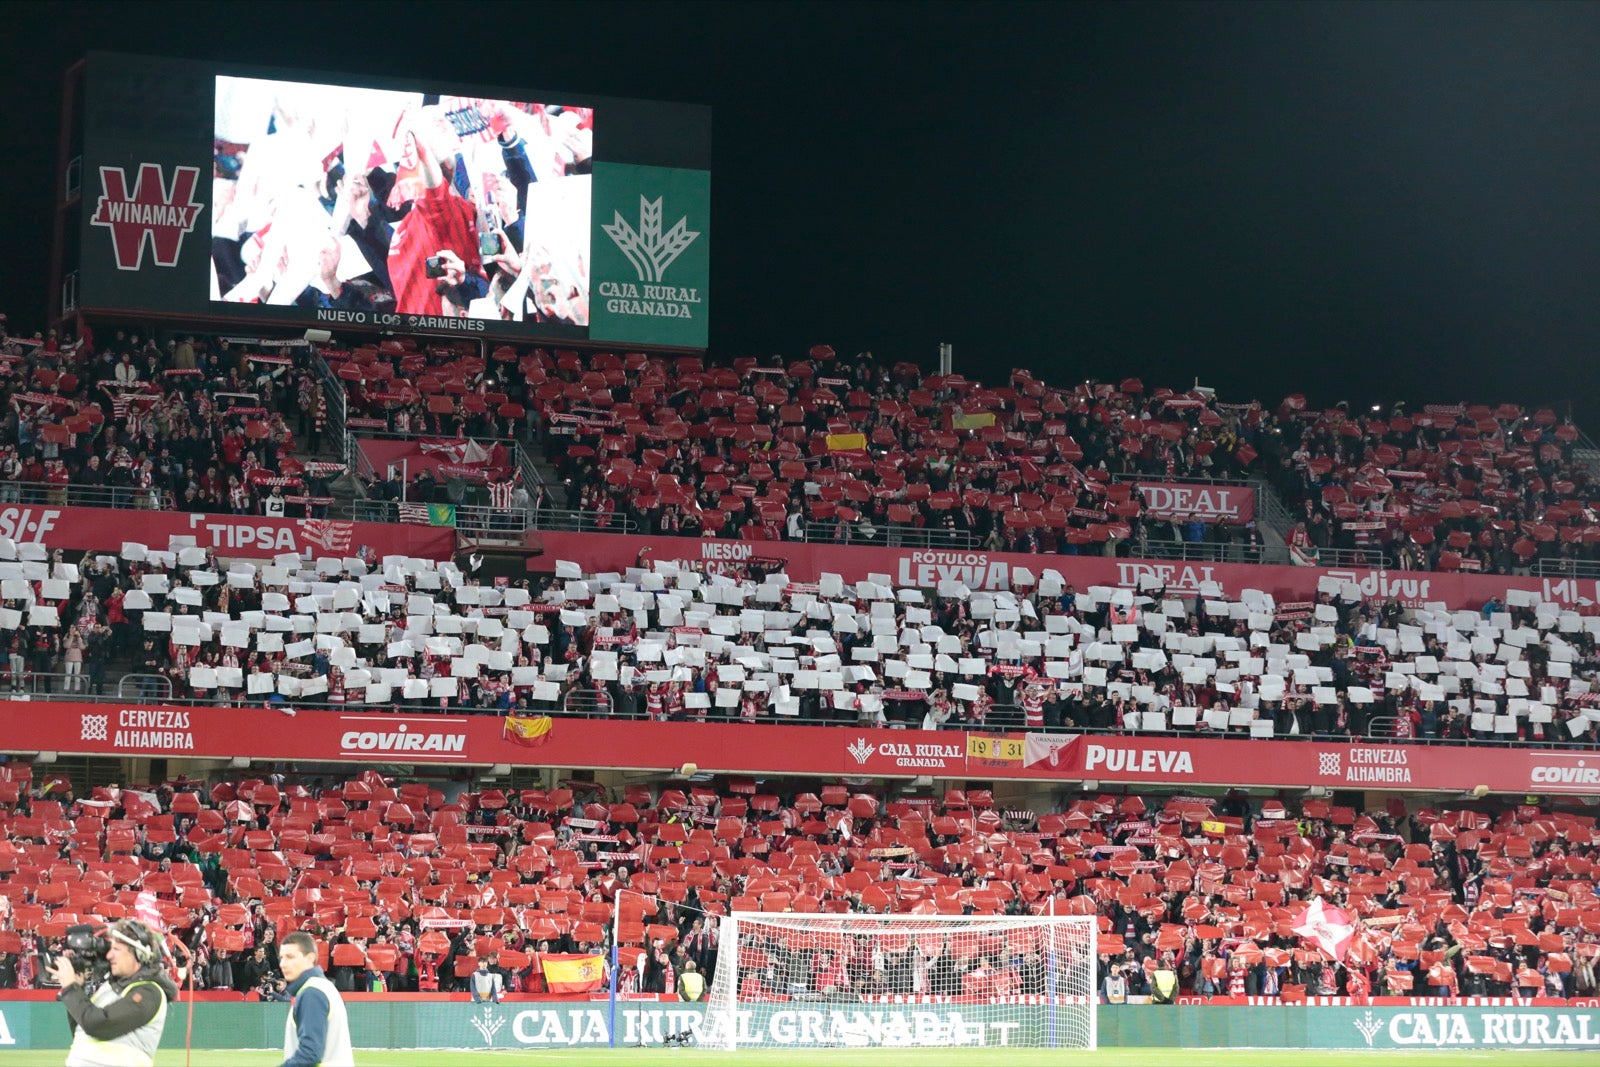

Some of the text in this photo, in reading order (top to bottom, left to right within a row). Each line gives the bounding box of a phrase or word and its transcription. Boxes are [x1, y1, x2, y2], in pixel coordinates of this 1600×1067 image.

[108, 201, 188, 228] WINAMAX
[599, 282, 701, 303] CAJA RURAL
[607, 300, 692, 318] GRANADA
[317, 310, 485, 331] NUEVO LOS CARMENES
[206, 524, 297, 551] TIPSA
[702, 541, 752, 560] MESÓN
[912, 549, 988, 565] RÓTULOS
[898, 557, 1010, 591] LEYVA
[1116, 563, 1224, 592] IDEAL
[1360, 571, 1430, 599] disur
[119, 710, 190, 729] CERVEZAS
[113, 731, 194, 750] ALHAMBRA
[879, 743, 963, 758] CAJA RURAL
[971, 739, 1022, 756] 19 31
[896, 758, 946, 769] GRANADA
[1085, 744, 1194, 773] PULEVA
[1350, 748, 1408, 765] CERVEZAS
[1346, 766, 1412, 783] ALHAMBRA
[512, 1010, 609, 1045] CAJA
[623, 1010, 763, 1043] RURAL
[1389, 1013, 1600, 1046] CAJA RURAL
